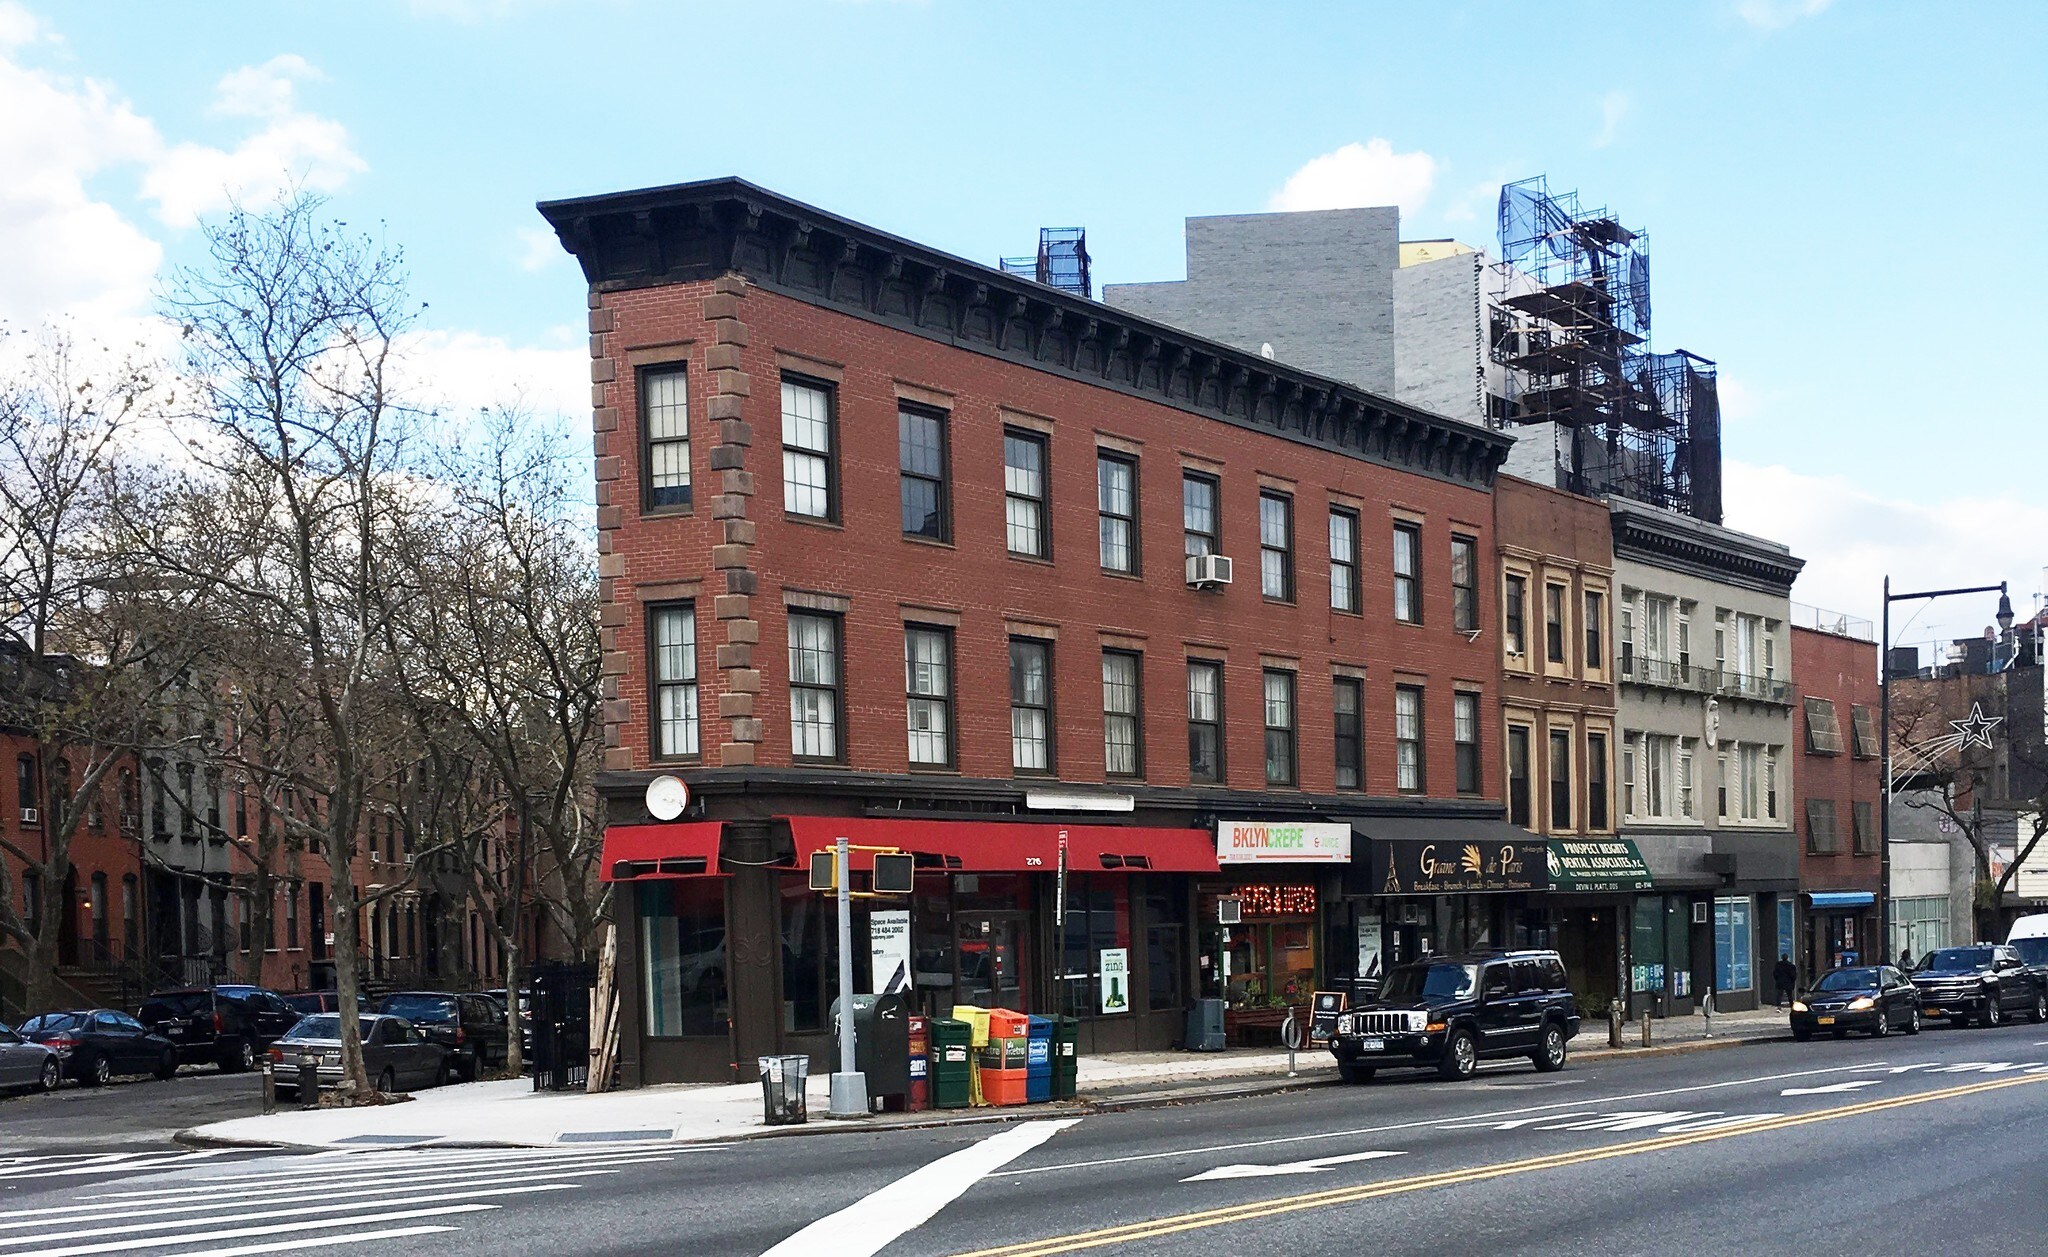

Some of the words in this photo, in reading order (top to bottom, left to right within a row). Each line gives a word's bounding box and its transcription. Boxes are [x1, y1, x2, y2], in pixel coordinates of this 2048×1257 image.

[1314, 837, 1320, 848] &
[1562, 843, 1600, 854] PROSPECT
[1600, 843, 1629, 854] HEIGHTS
[1025, 857, 1042, 866] 276
[1420, 844, 1457, 879] Graine
[1486, 856, 1497, 874] de
[1500, 845, 1523, 876] Paris
[1561, 857, 1591, 869] DENTAL
[1413, 881, 1440, 891] Breakfast
[1443, 880, 1463, 890] Brunch
[1466, 880, 1483, 889] Lunch
[1486, 879, 1505, 889] Dinner
[1006, 1046, 1026, 1055] metro
